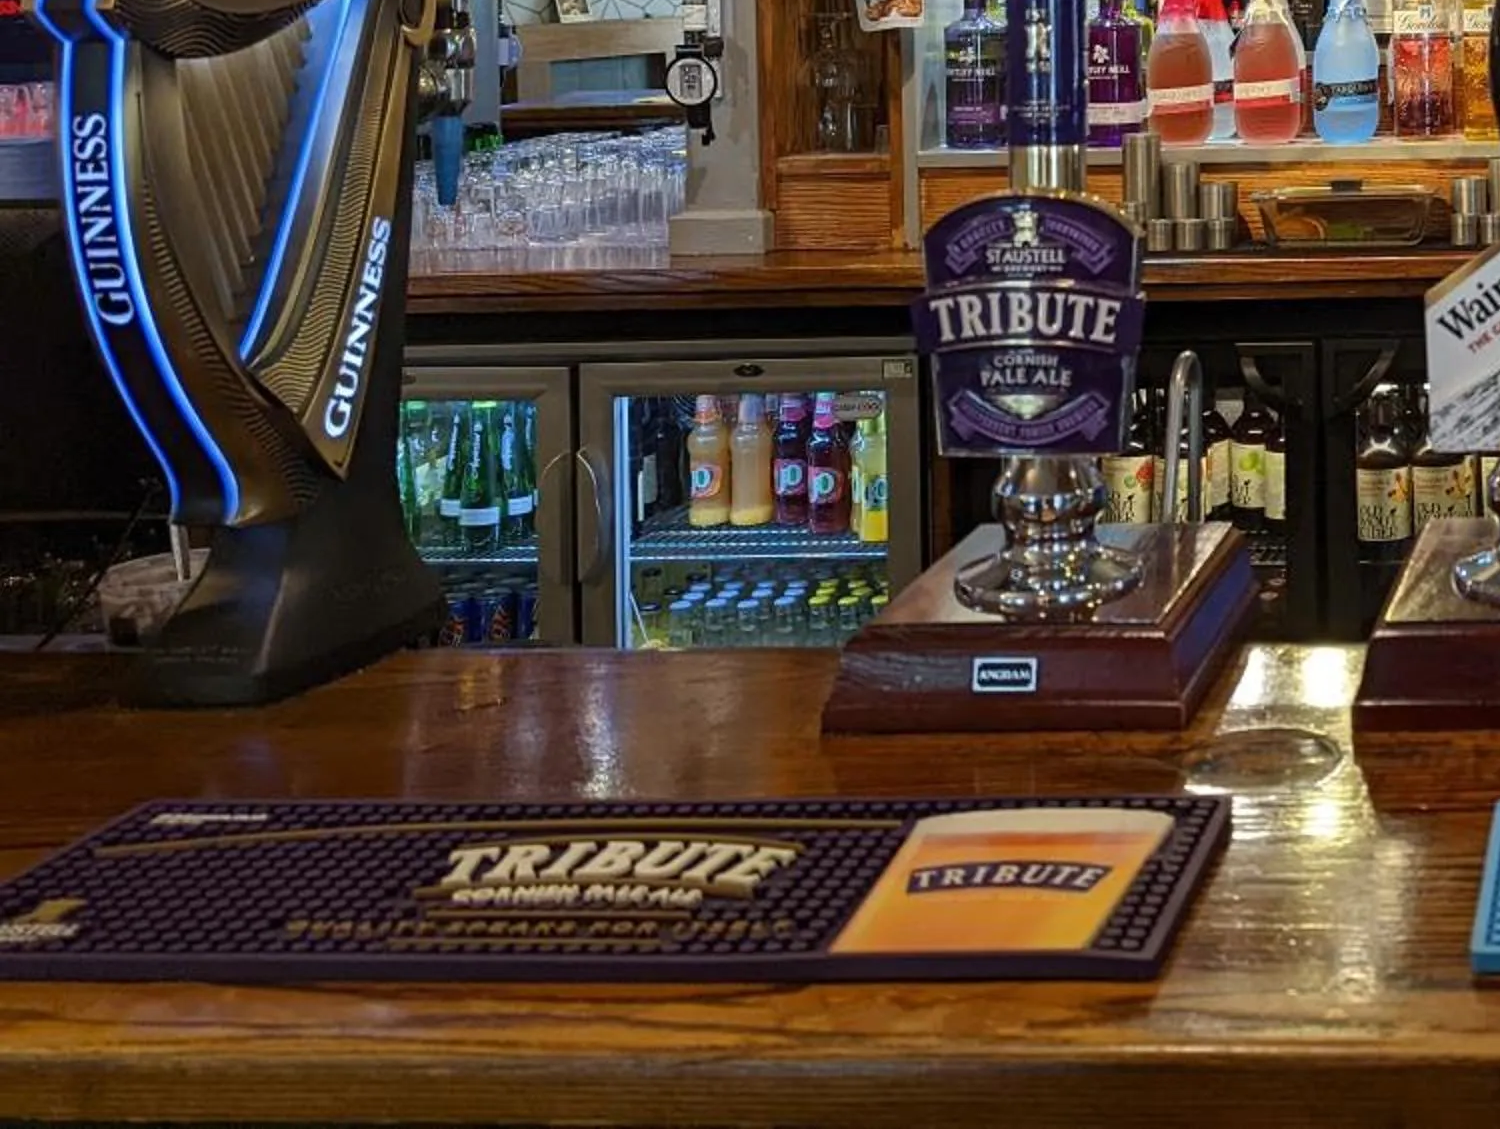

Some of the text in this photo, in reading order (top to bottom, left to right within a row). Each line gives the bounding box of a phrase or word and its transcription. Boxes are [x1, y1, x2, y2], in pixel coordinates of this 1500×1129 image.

[72, 112, 136, 327] GUINNESS
[1001, 248, 1067, 264] AUSTELL
[324, 216, 392, 439] GUINNESS
[929, 291, 1121, 344] TRIBUTE
[979, 367, 1073, 387] PALE ALE
[440, 840, 799, 889] TRIBUTE
[913, 863, 1106, 889] TRIBUTE
